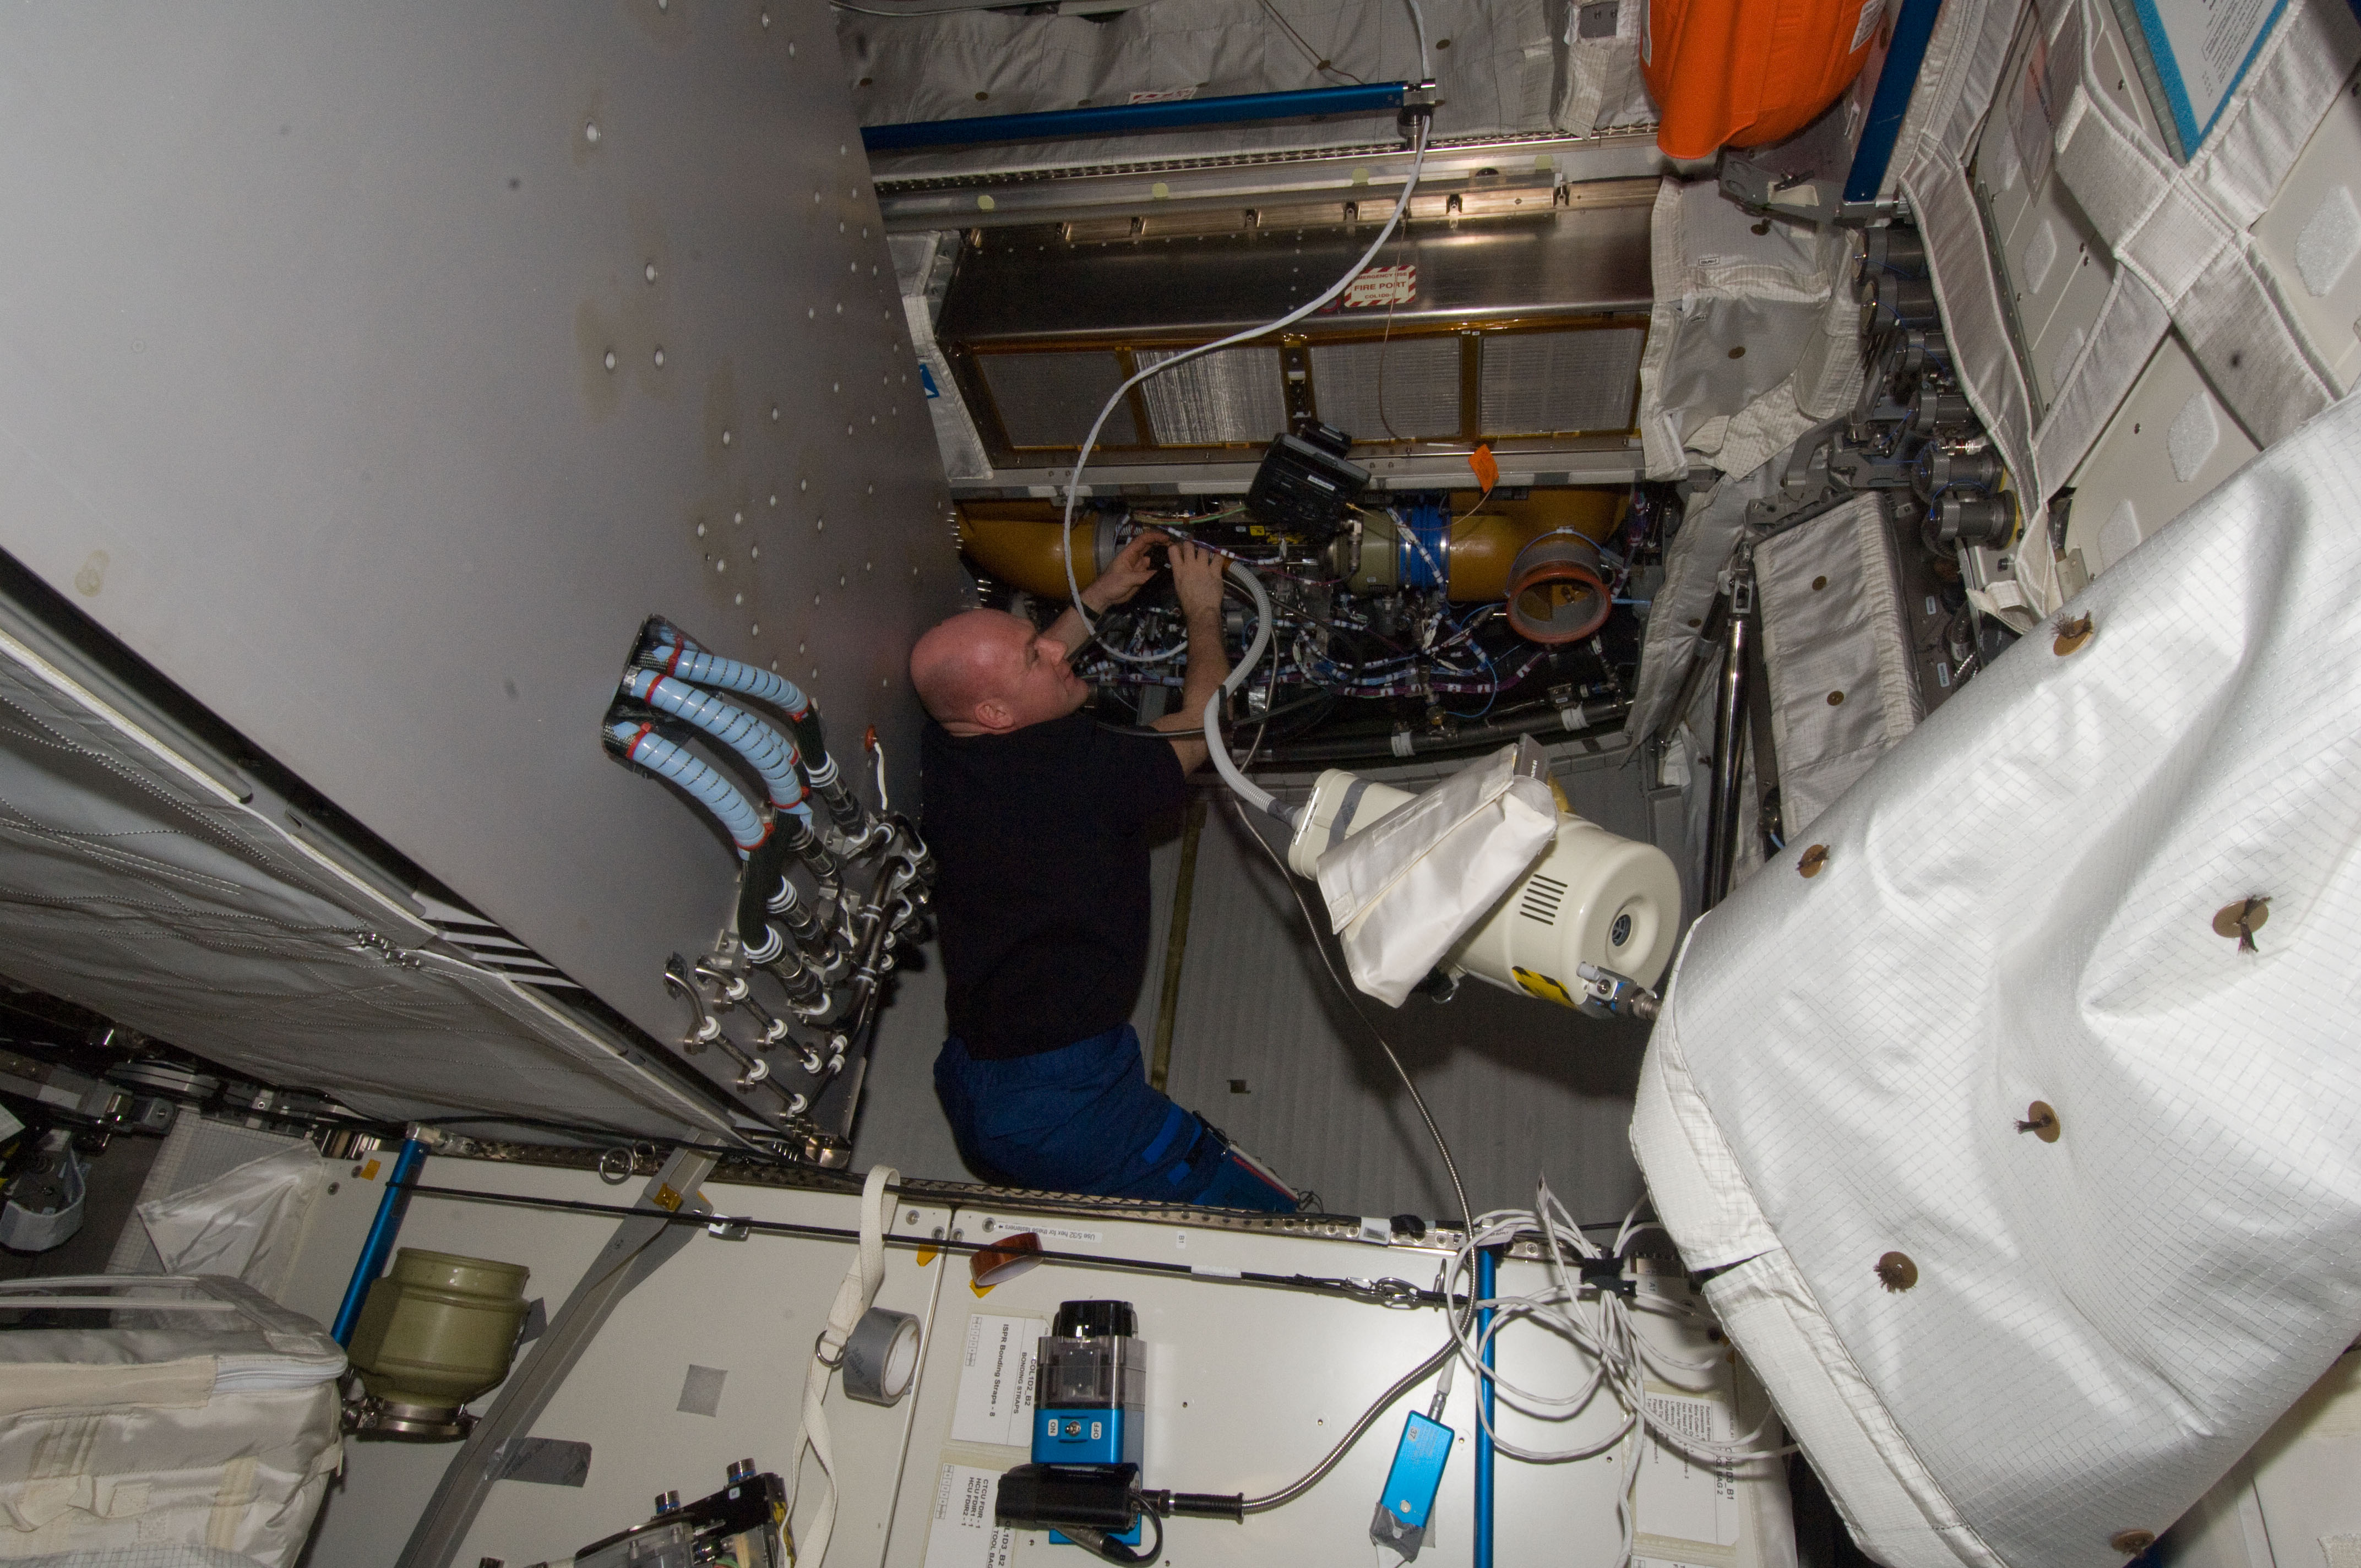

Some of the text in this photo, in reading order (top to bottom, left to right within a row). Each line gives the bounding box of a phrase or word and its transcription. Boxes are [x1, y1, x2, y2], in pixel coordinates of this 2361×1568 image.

[1649, 1282, 1656, 1291] A1
[994, 1345, 1005, 1377] Bonding
[991, 1379, 1000, 1404] Straps
[1014, 1352, 1027, 1414] BONDING STRAPS
[1025, 1359, 1036, 1406] COL1D2_B2
[1051, 1422, 1056, 1433] ON
[1410, 1428, 1417, 1439] 37
[977, 1501, 985, 1518] FDIR
[998, 1521, 1011, 1566] OL1D3_B2
